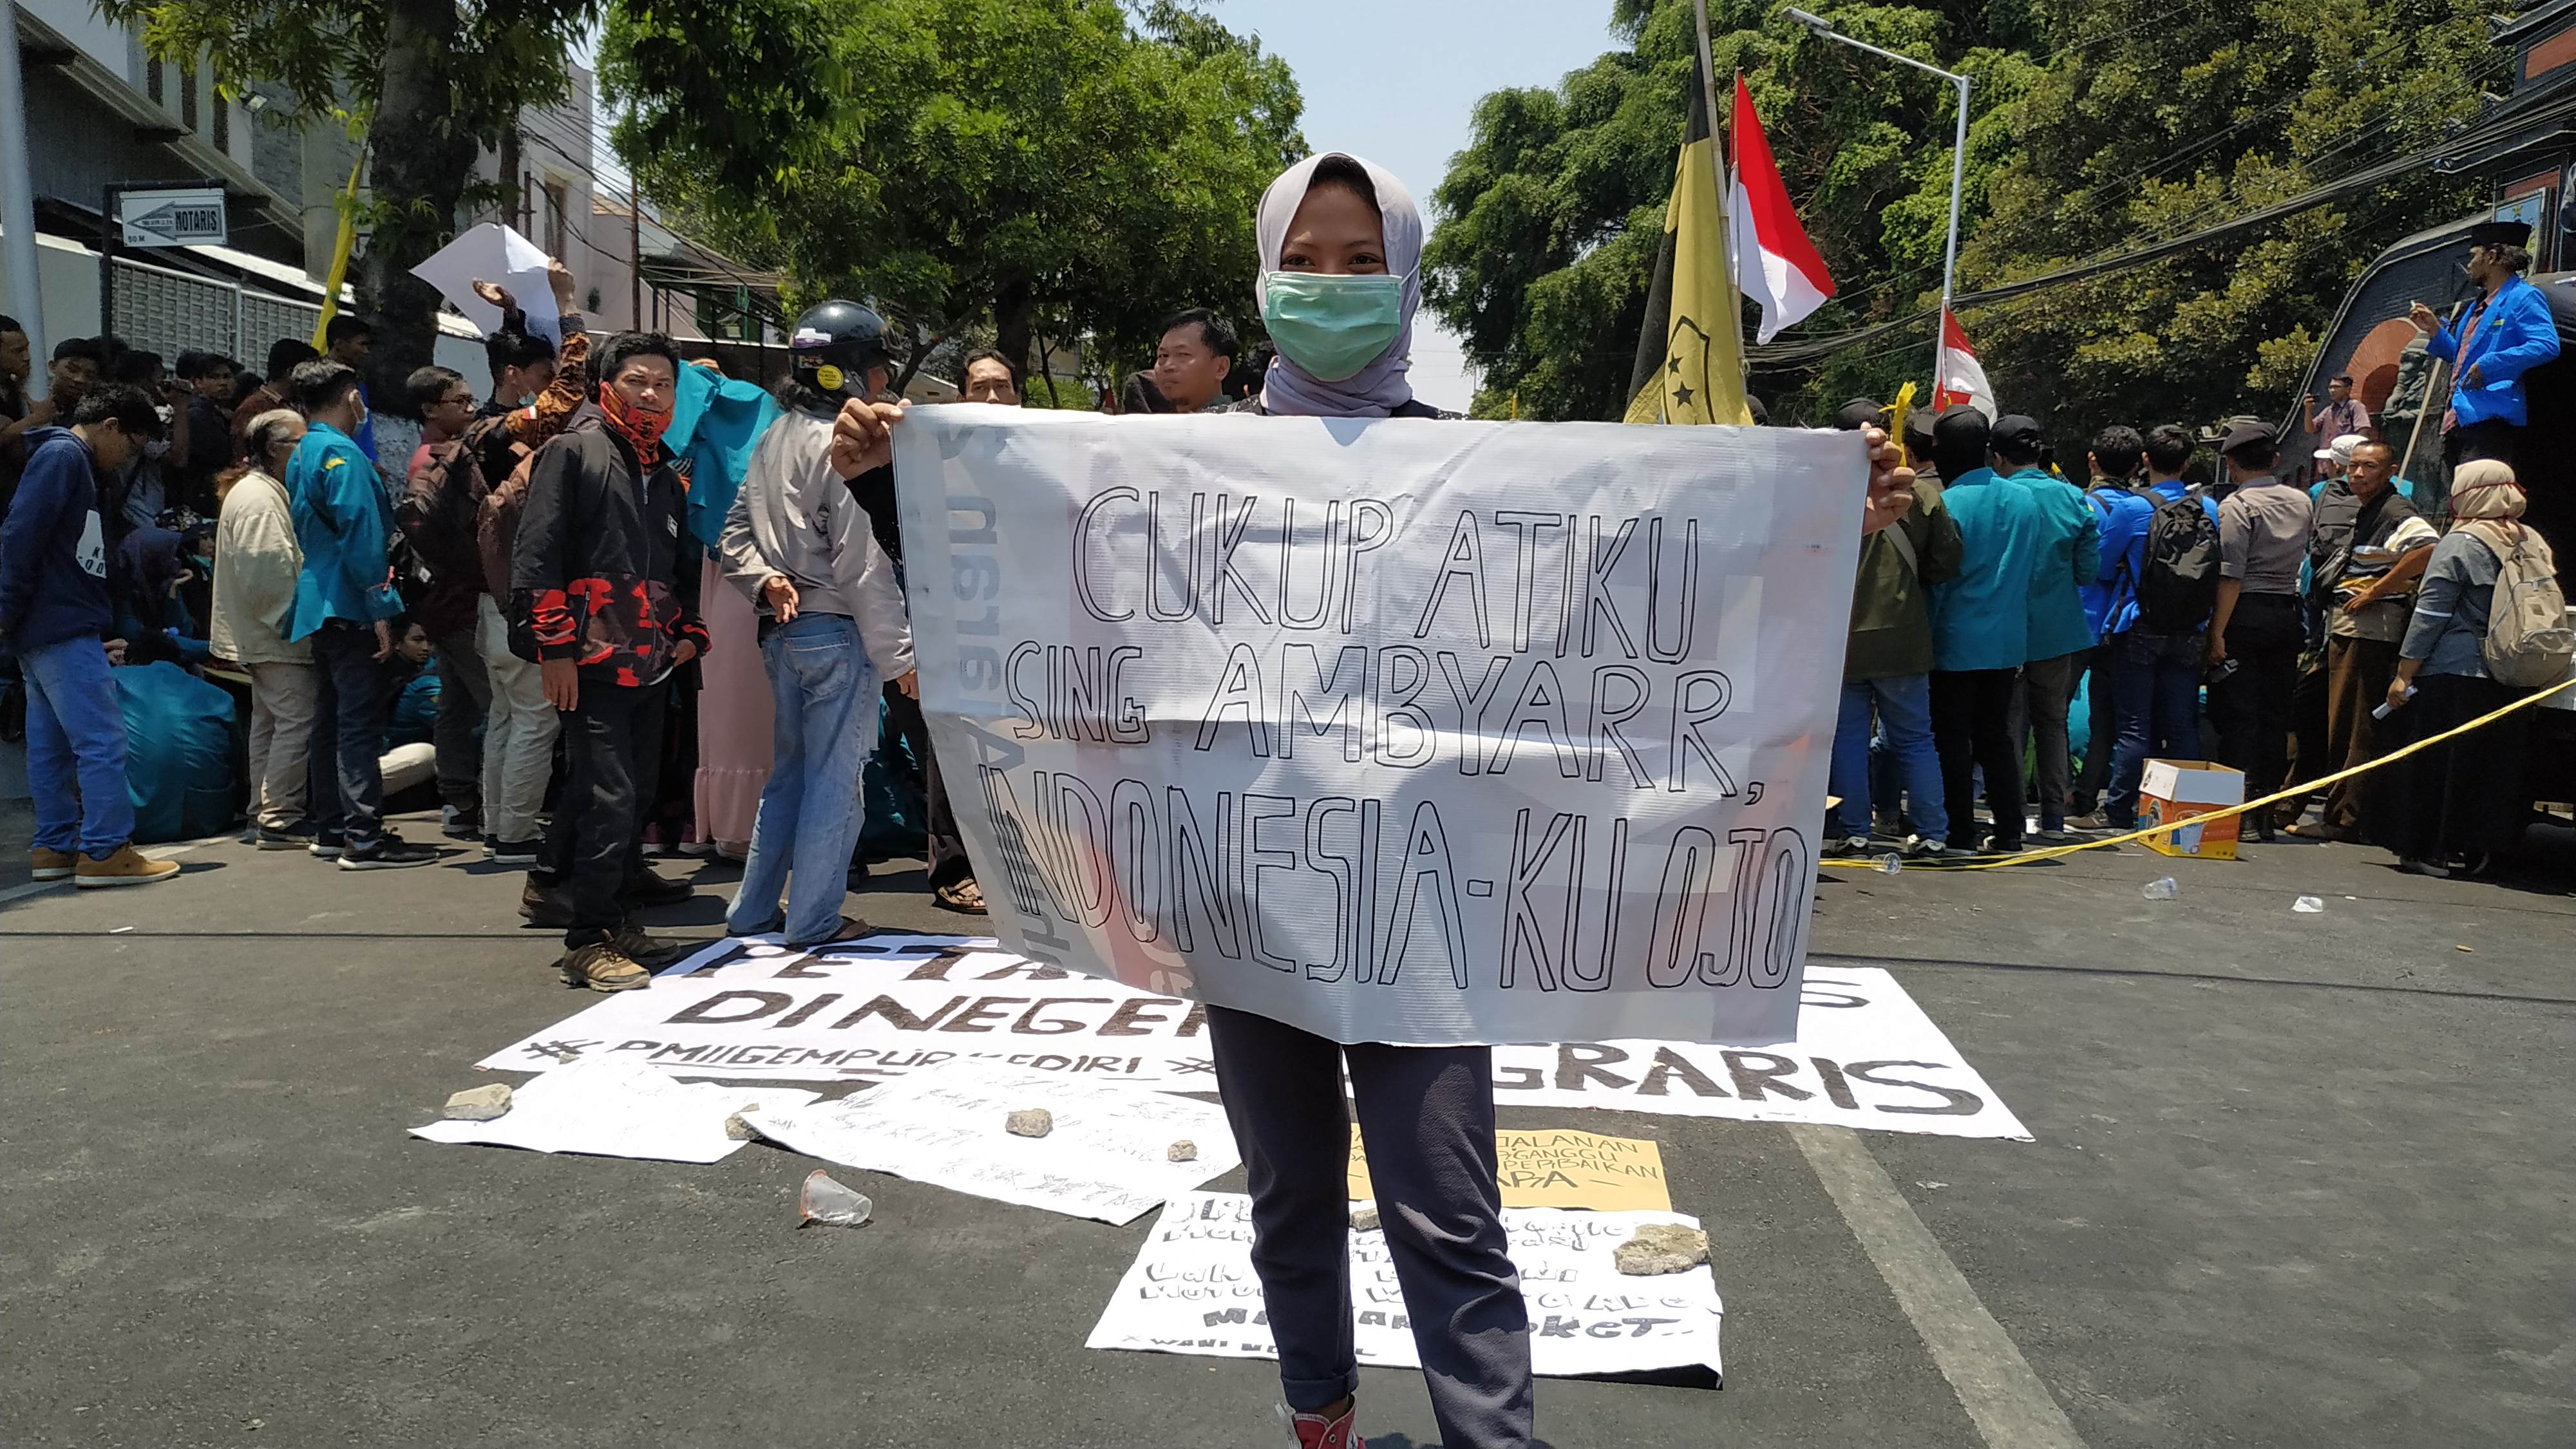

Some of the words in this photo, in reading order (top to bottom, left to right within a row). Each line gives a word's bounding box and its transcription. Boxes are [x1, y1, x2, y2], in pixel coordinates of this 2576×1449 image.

[175, 210, 217, 232] NOTARIS
[1072, 486, 1394, 634] CUKUP
[1414, 509, 1699, 665] ATIKU
[1005, 640, 1150, 744] SING
[1647, 826, 1808, 990] OJO
[681, 943, 1105, 981] PETA
[969, 1052, 1143, 1074] EDIRI
[1494, 1042, 1984, 1116] GRARIS
